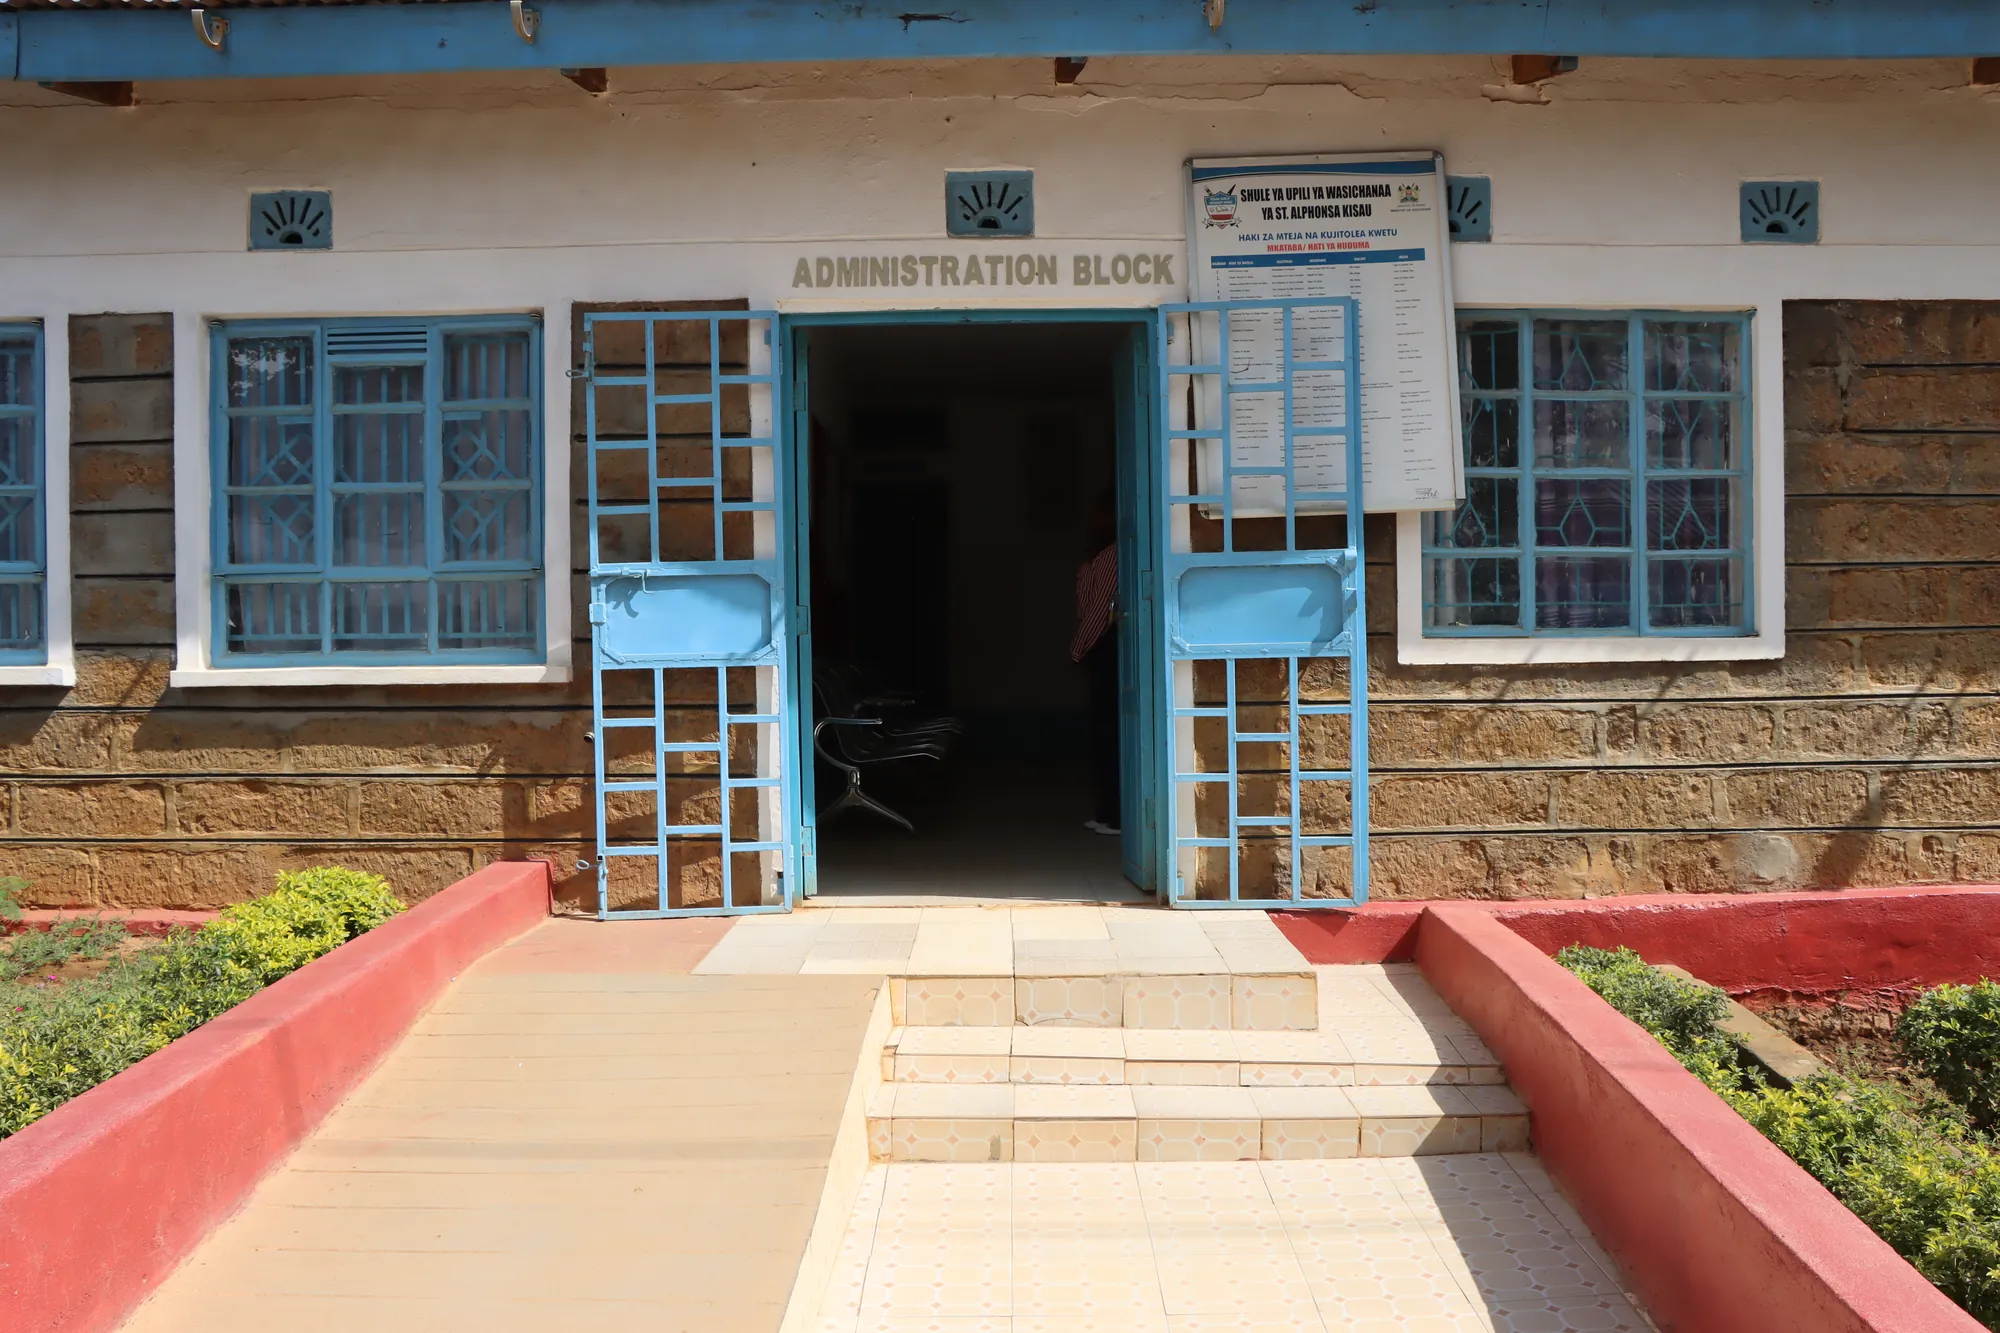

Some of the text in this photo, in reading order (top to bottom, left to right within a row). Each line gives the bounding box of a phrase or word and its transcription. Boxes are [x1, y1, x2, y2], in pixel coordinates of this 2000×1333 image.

[1240, 188, 1271, 202] SHULE
[1271, 188, 1286, 201] YA
[1286, 187, 1311, 200] UPILI
[1311, 186, 1325, 200] YA
[1325, 184, 1392, 199] WASICHANAA
[1261, 204, 1372, 221] YA ST. ALPHONSA KISAU
[1238, 228, 1398, 242] HAKI ZA MTEJA NA KUJITOLEA KWETU
[1267, 241, 1370, 252] MKATABA/ HATI YA HUDUMA
[791, 253, 1175, 288] ADMINISTRATION BLOCK
